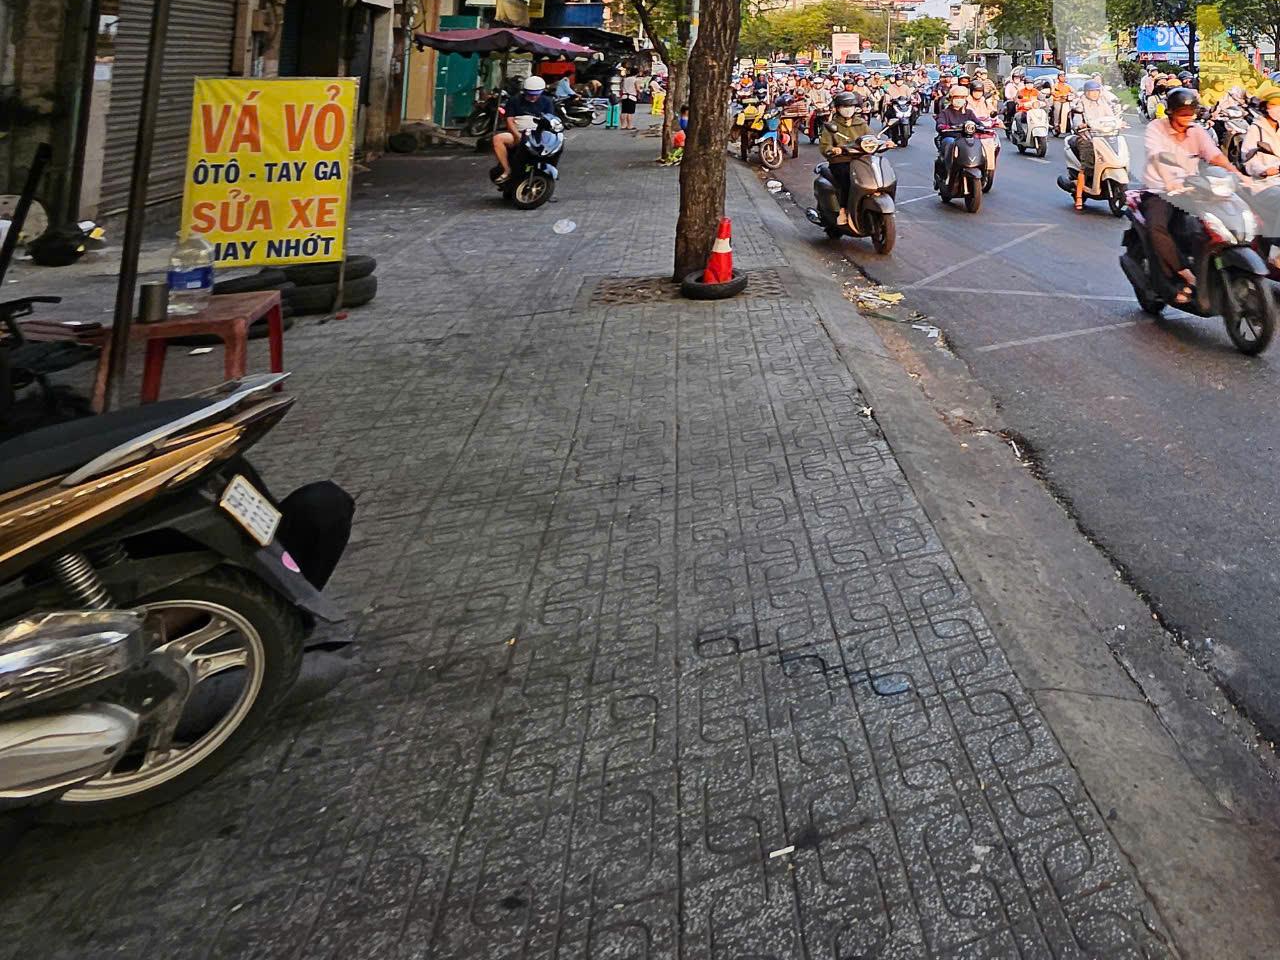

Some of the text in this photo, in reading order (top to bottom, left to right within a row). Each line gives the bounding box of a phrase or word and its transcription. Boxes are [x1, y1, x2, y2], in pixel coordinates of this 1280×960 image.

[201, 84, 346, 154] VÁ VỎ
[192, 158, 241, 186] ÔTÔ
[264, 160, 308, 184] TAY
[313, 160, 342, 182] GA
[190, 188, 340, 235] SỬA XE
[265, 232, 336, 259] NHỚT
